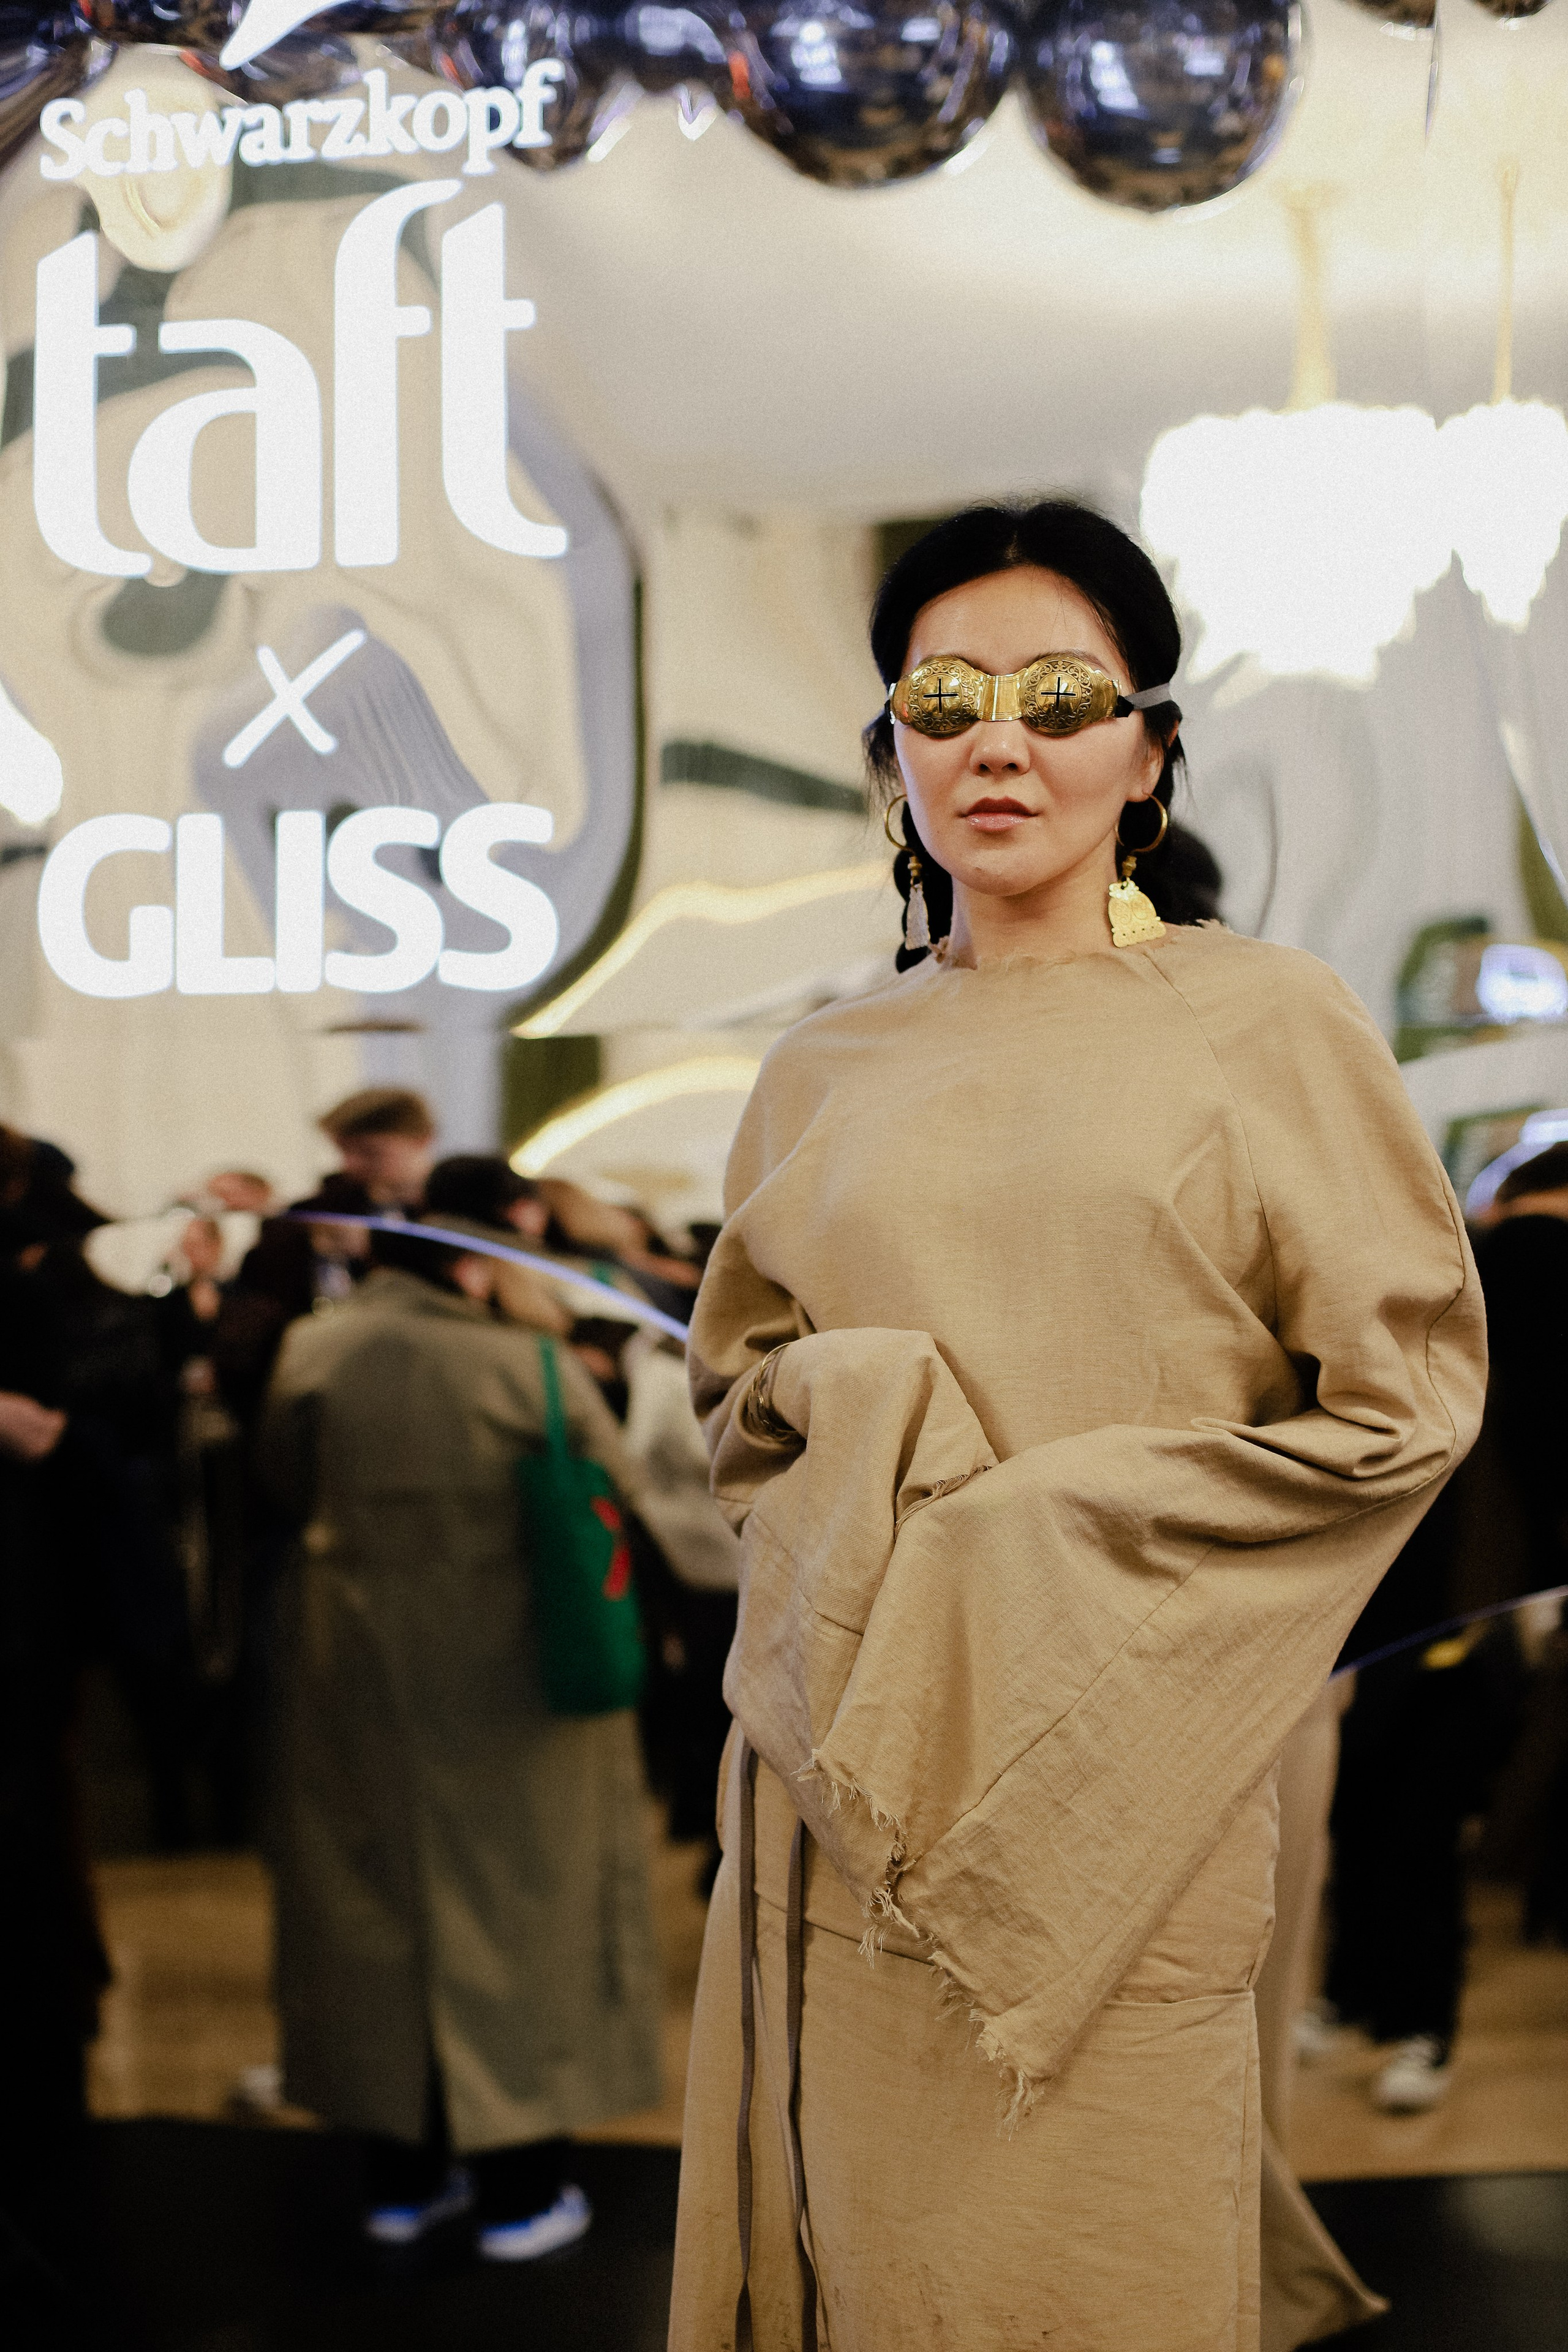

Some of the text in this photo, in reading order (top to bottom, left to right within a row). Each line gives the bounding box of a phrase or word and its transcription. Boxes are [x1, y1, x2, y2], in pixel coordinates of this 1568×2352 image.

[40, 59, 566, 181] Schwarzkopf
[32, 179, 569, 578] taft
[37, 802, 559, 998] GLISS
